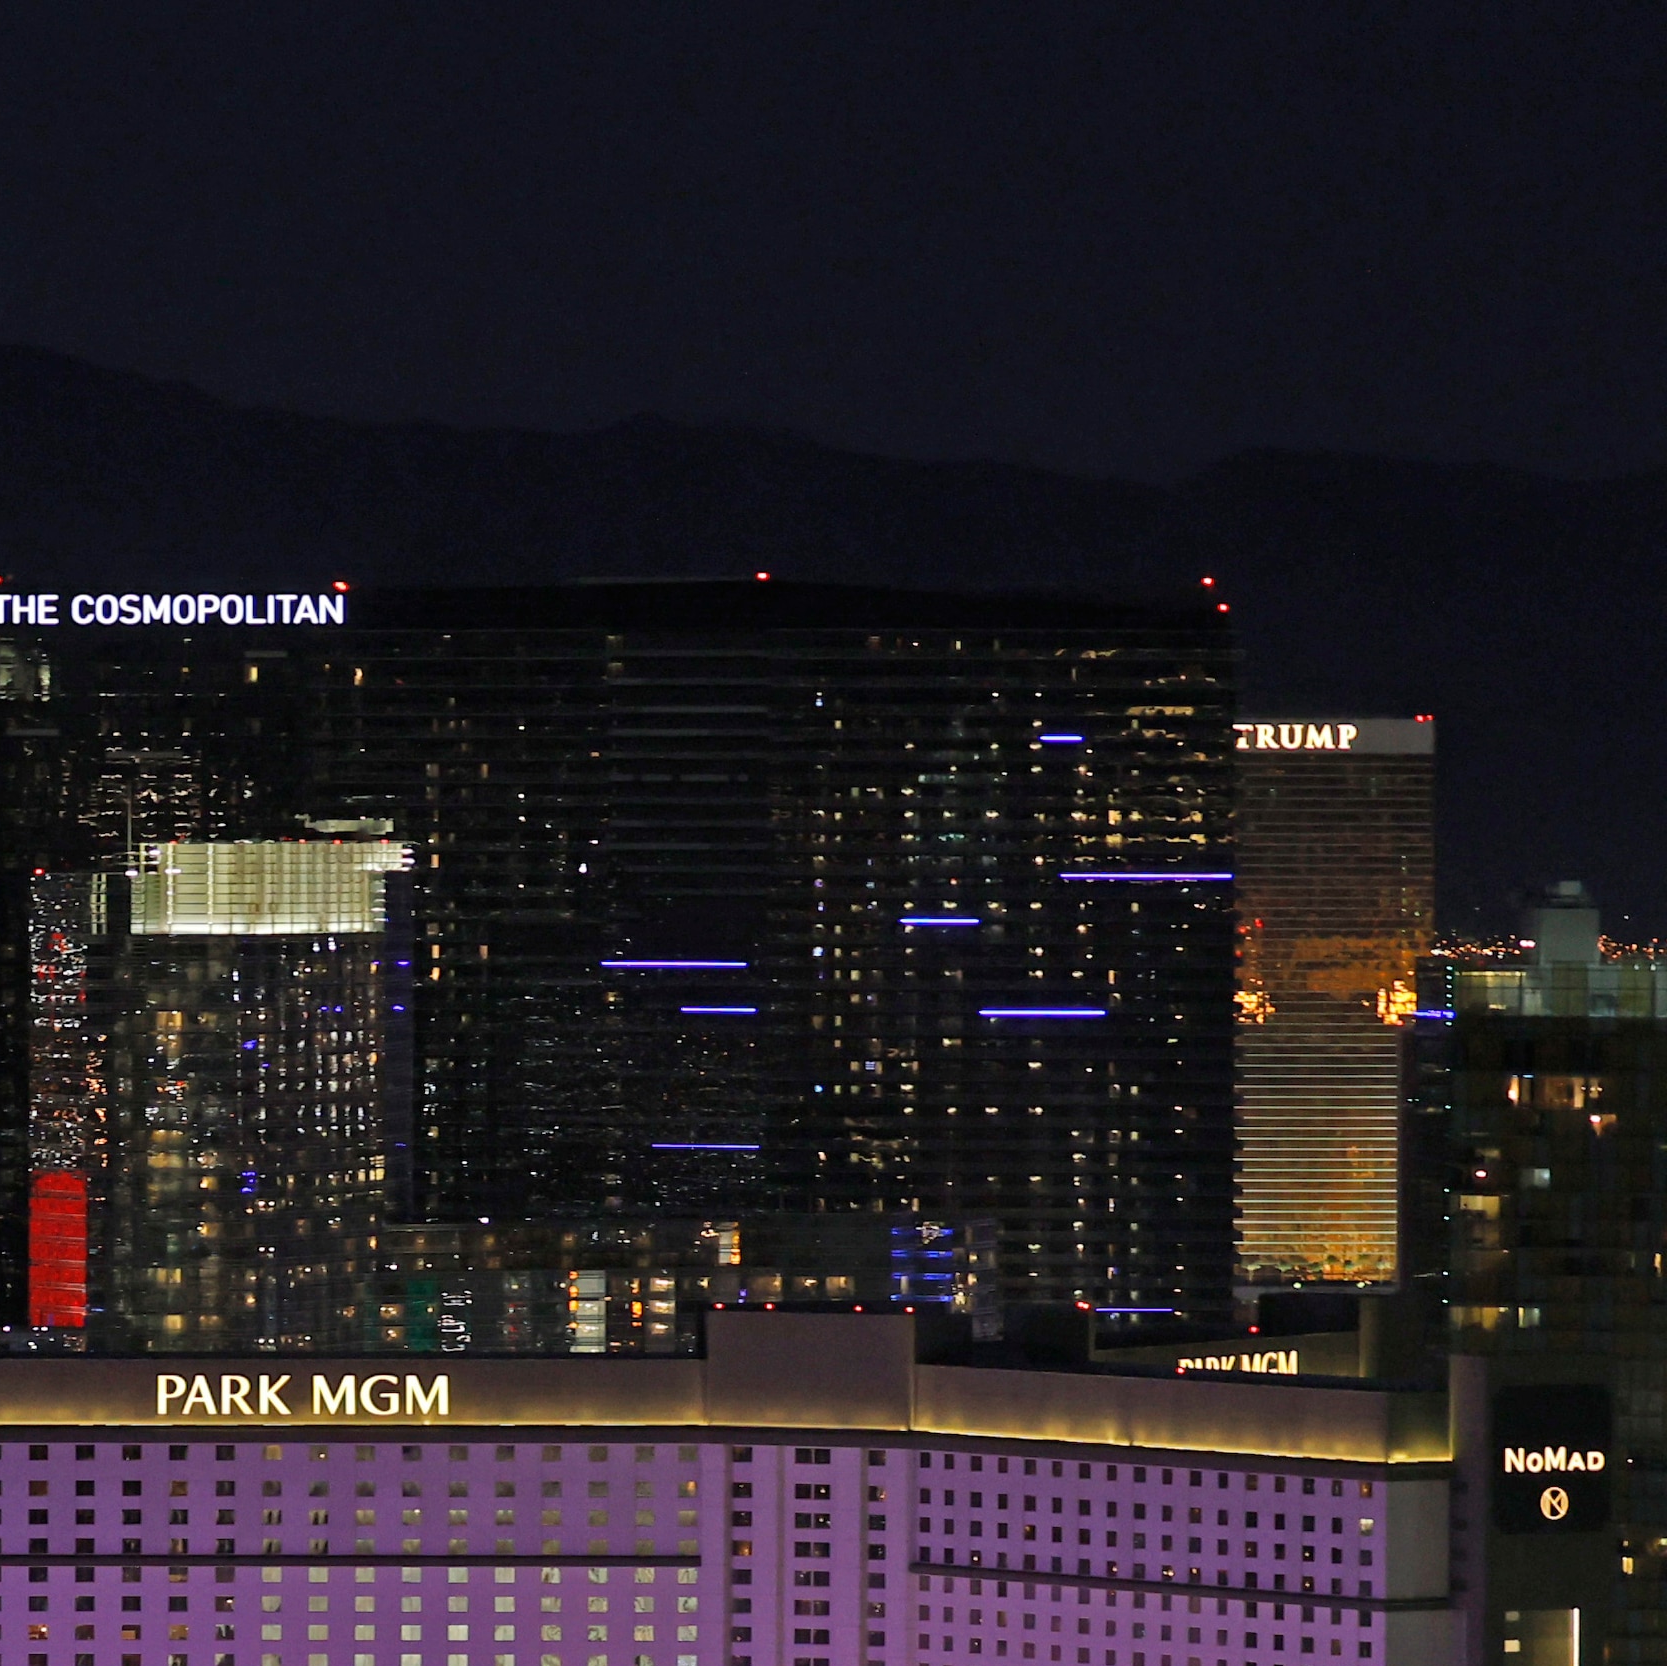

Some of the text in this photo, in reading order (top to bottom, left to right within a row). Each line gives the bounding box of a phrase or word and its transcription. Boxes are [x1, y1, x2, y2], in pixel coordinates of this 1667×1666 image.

[70, 594, 345, 625] COSMOPOLITAN
[1232, 723, 1358, 750] TRUMP
[156, 1374, 449, 1416] PARK MGM
